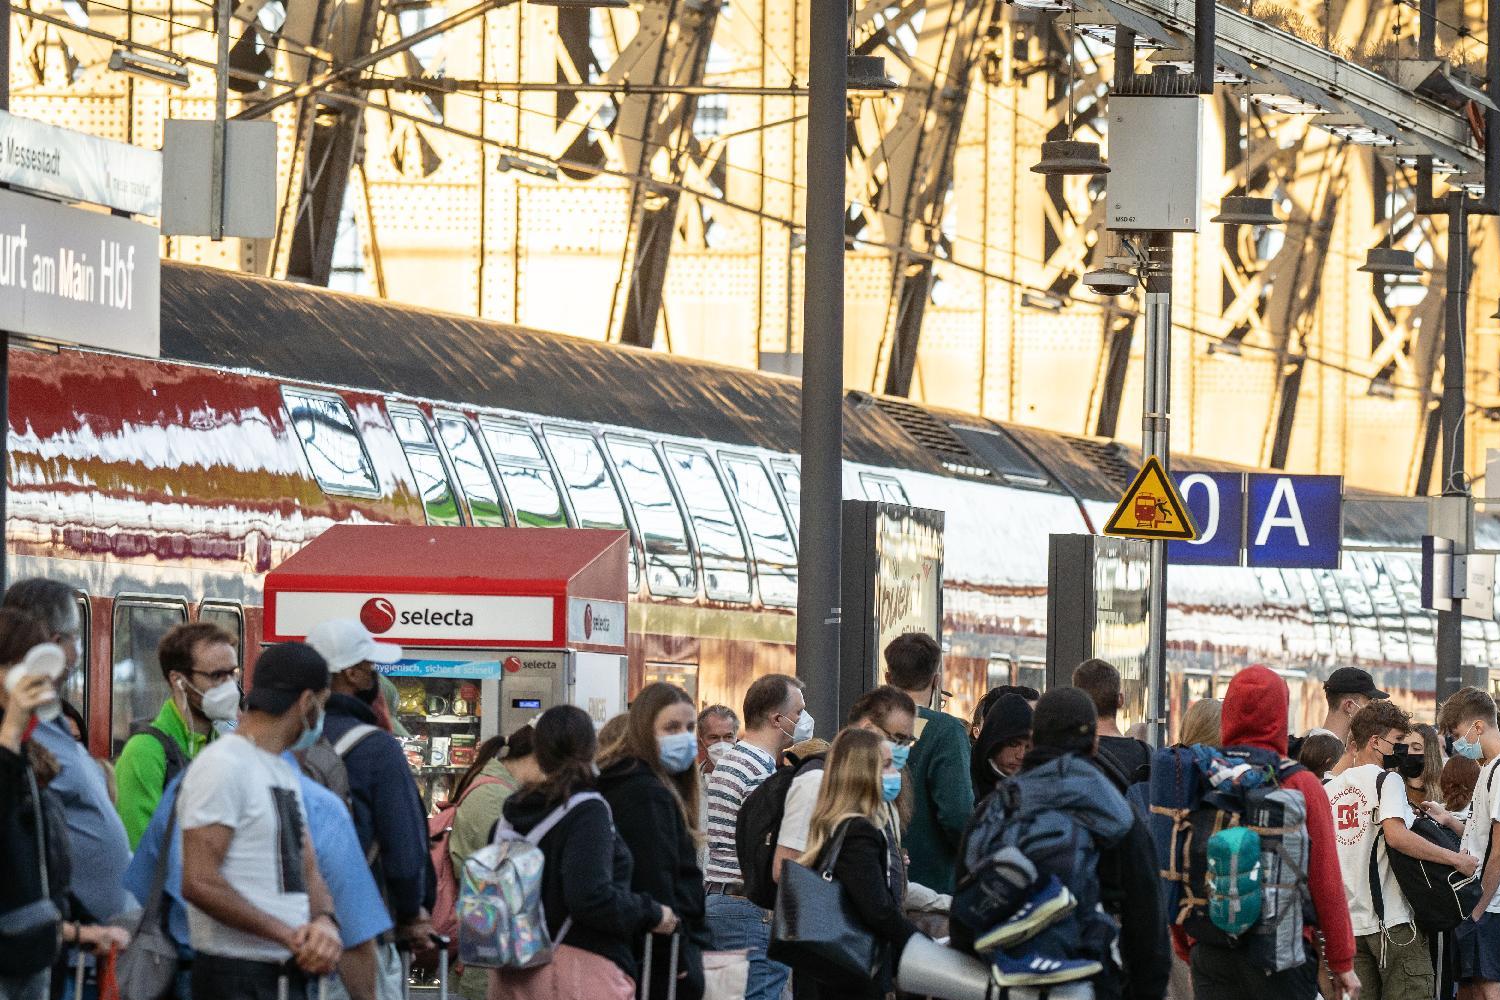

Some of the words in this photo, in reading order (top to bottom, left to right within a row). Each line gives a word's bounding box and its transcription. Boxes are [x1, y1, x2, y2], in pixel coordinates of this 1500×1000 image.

[7, 137, 60, 176] Messestadt
[32, 253, 55, 295] am
[58, 247, 95, 303] Main
[101, 239, 135, 310] Hbf
[1255, 478, 1310, 546] A
[400, 607, 474, 627] selecta
[592, 614, 610, 632] selecta
[522, 660, 557, 669] selecta
